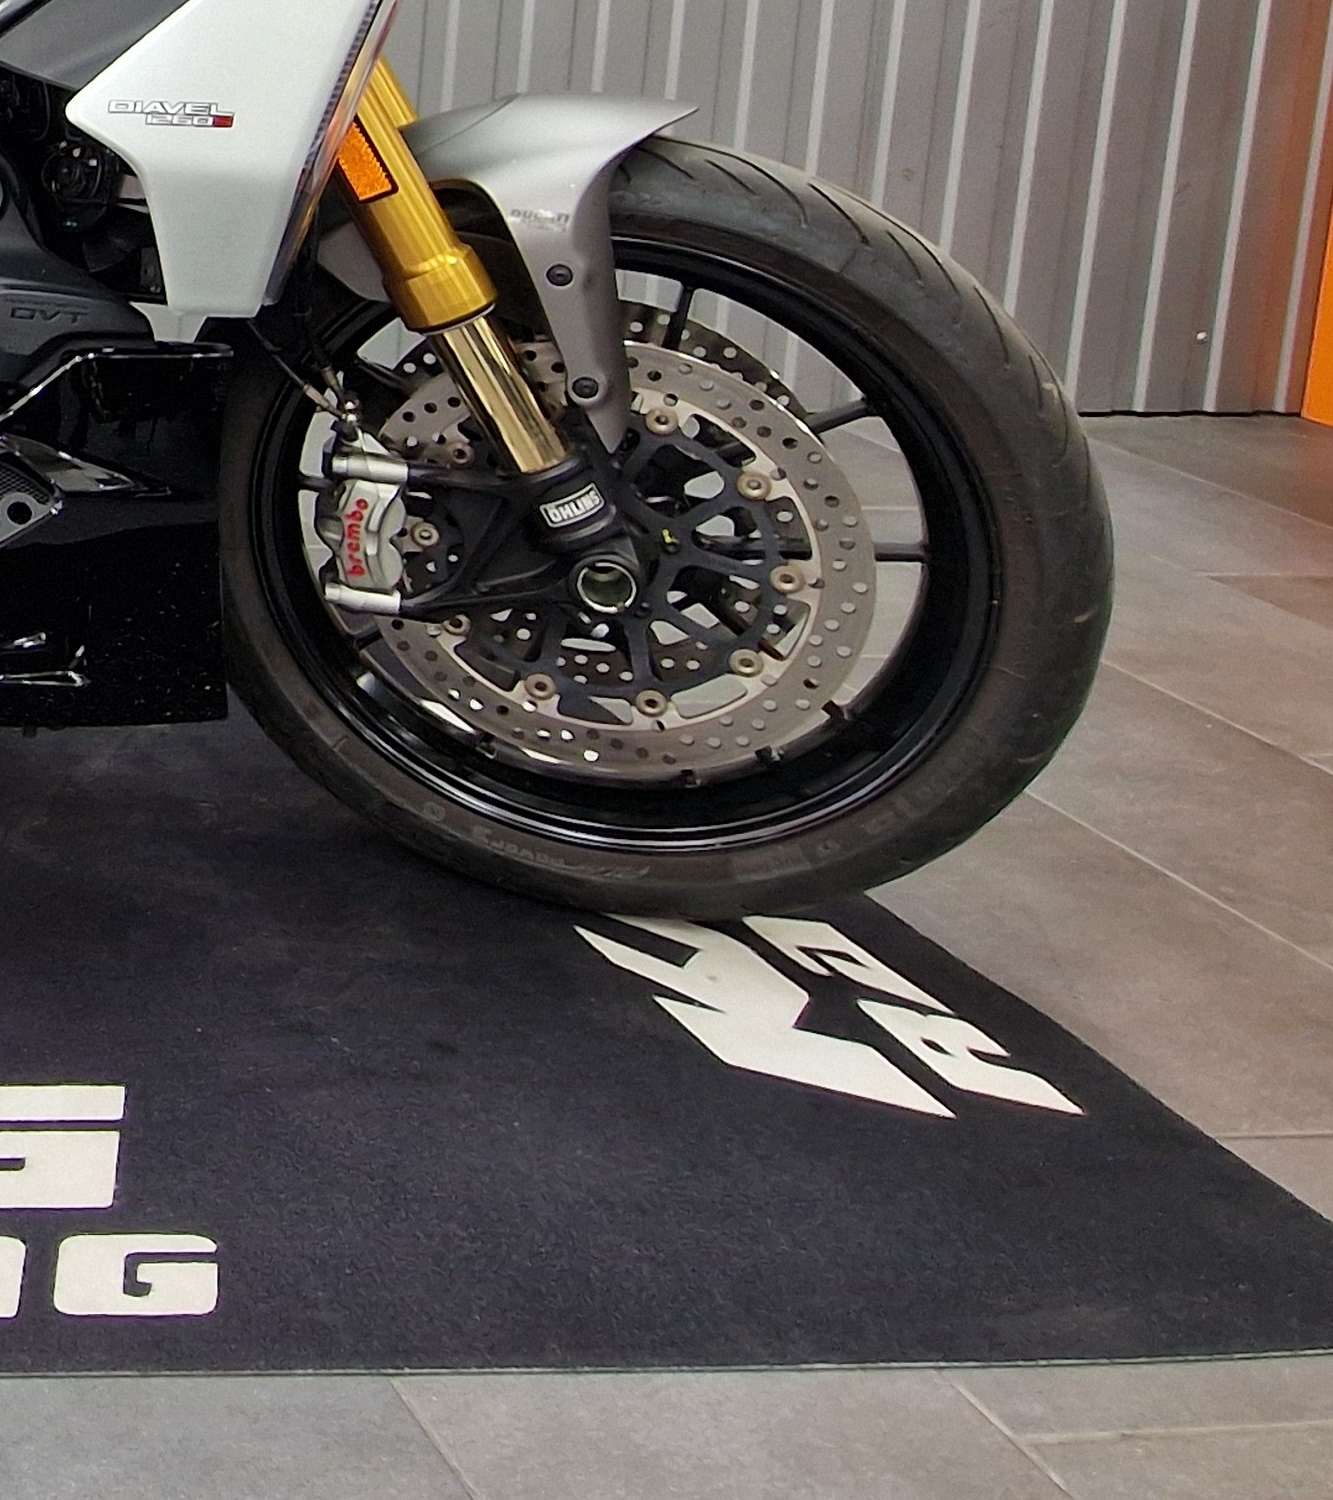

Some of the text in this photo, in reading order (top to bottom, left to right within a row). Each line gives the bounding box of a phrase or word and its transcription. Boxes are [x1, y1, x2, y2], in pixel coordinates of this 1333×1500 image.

[108, 100, 234, 117] DIAVEL
[10, 306, 90, 325] DVT
[343, 498, 369, 577] brembo
